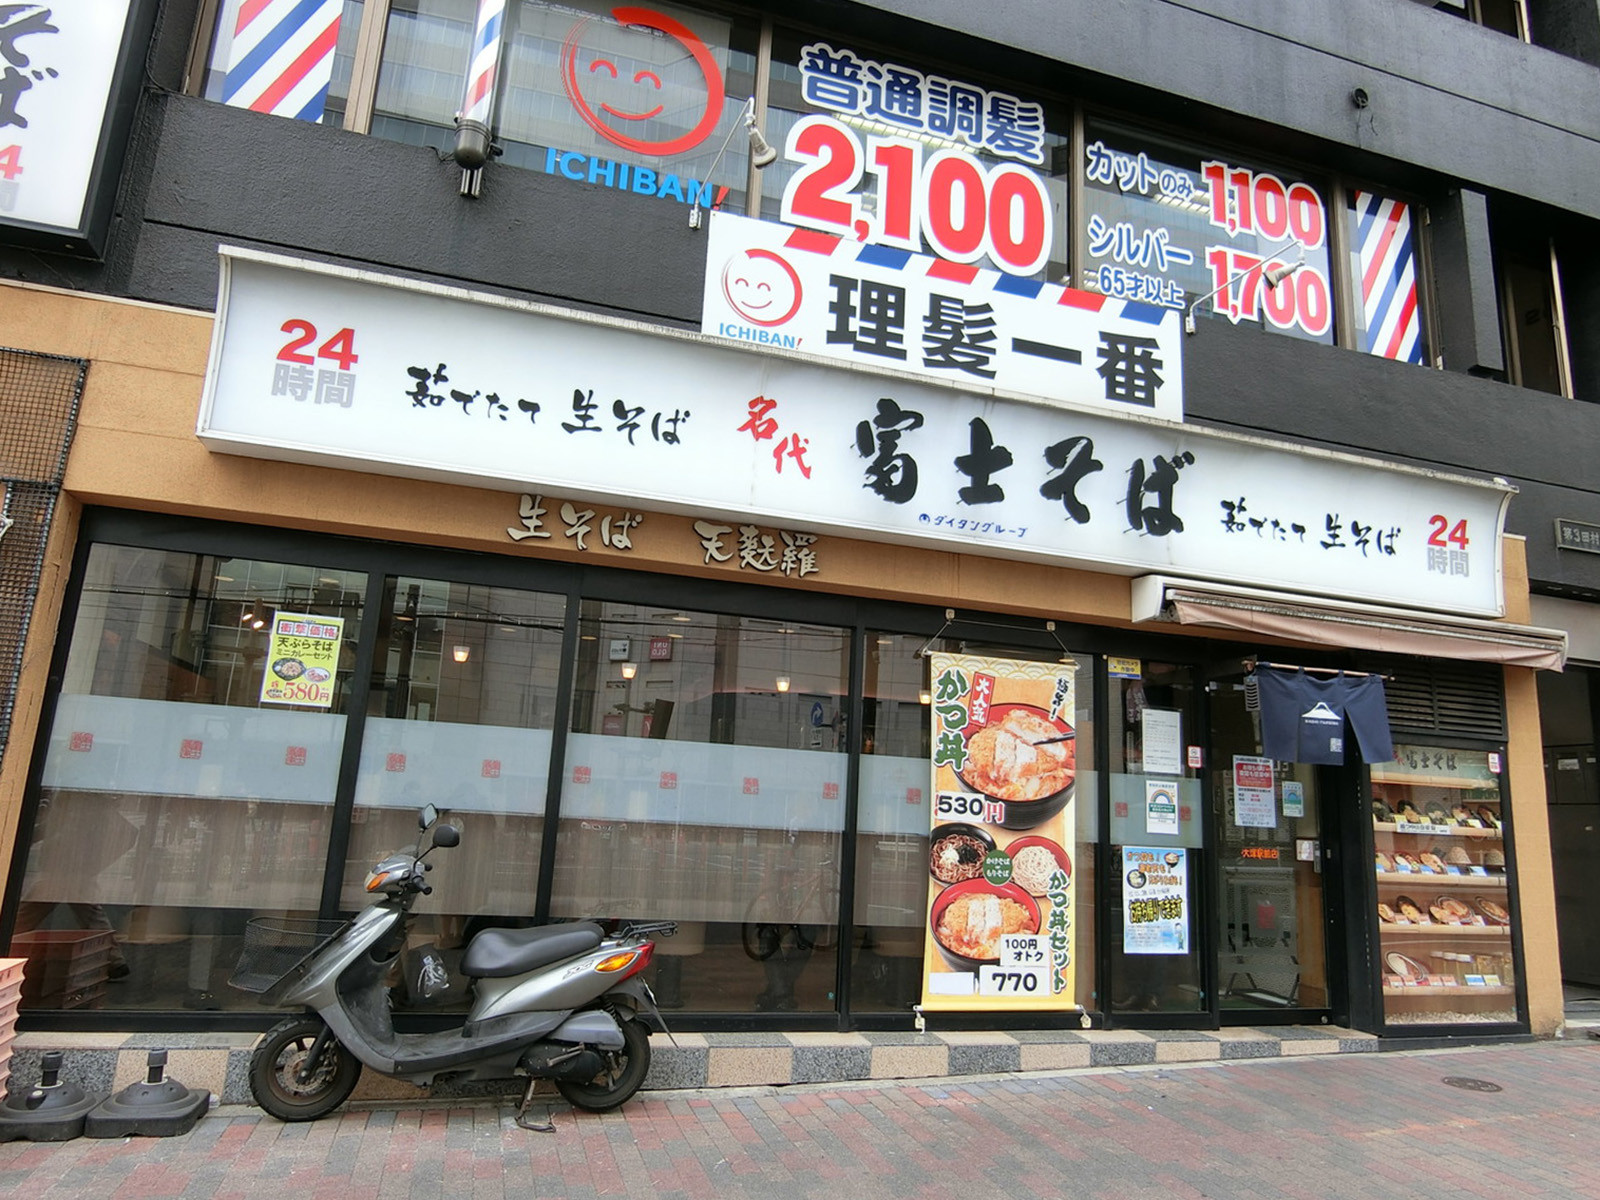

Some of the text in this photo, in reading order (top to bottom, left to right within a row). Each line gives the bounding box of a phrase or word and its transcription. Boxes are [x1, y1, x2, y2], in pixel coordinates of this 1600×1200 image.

[802, 44, 1043, 164] 普通調髪
[0, 144, 23, 180] 4
[545, 147, 730, 211] ICHIBAN!
[788, 121, 1047, 271] 2,100
[1203, 163, 1323, 248] 1,100
[1088, 214, 1330, 333] シルバー 1,700
[1099, 264, 1188, 309] 65才以上
[275, 318, 358, 371] 24
[719, 322, 803, 350] ICHIBAN!
[826, 273, 1164, 408] 理髪一番
[271, 362, 357, 409] 時間
[561, 389, 691, 445] 生そば
[736, 395, 812, 479] 名代
[853, 397, 1195, 538] 富士そば
[507, 493, 644, 551] 生そば
[933, 514, 1029, 538] ダイタングループ
[1319, 513, 1402, 558] 生そば
[1427, 515, 1470, 551] 24
[1426, 547, 1470, 578] 時間
[935, 668, 970, 771] かつ丼
[1005, 939, 1038, 949] 100円
[1013, 951, 1043, 961] オトク
[992, 972, 1037, 992] 770
